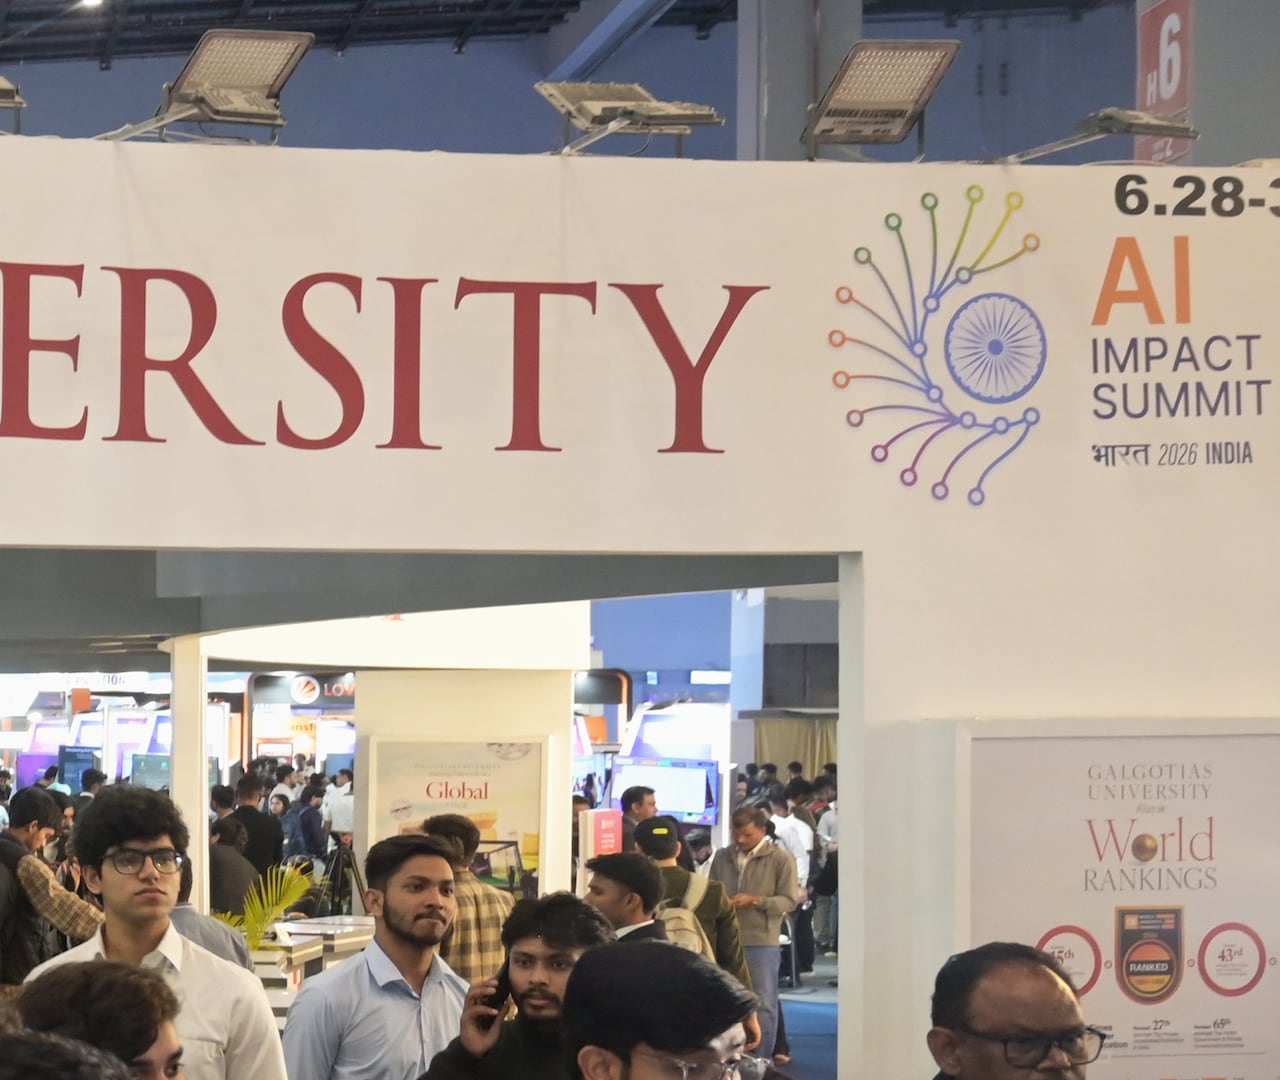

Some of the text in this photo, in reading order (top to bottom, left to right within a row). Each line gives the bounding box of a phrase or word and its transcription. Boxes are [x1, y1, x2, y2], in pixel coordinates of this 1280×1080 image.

[1091, 235, 1191, 325] AI
[1092, 335, 1261, 374] IMPACT
[1093, 380, 1272, 420] SUMMIT
[1092, 441, 1253, 467] भारत 2026 INDIA
[1087, 763, 1213, 780] GALGOTIAS
[425, 781, 489, 800] Global
[1088, 783, 1212, 800] UNIVERSITY
[1083, 816, 1215, 862] World
[1083, 867, 1217, 891] RANKINGS
[1217, 947, 1243, 962] 43rd
[1129, 962, 1168, 972] RANKED
